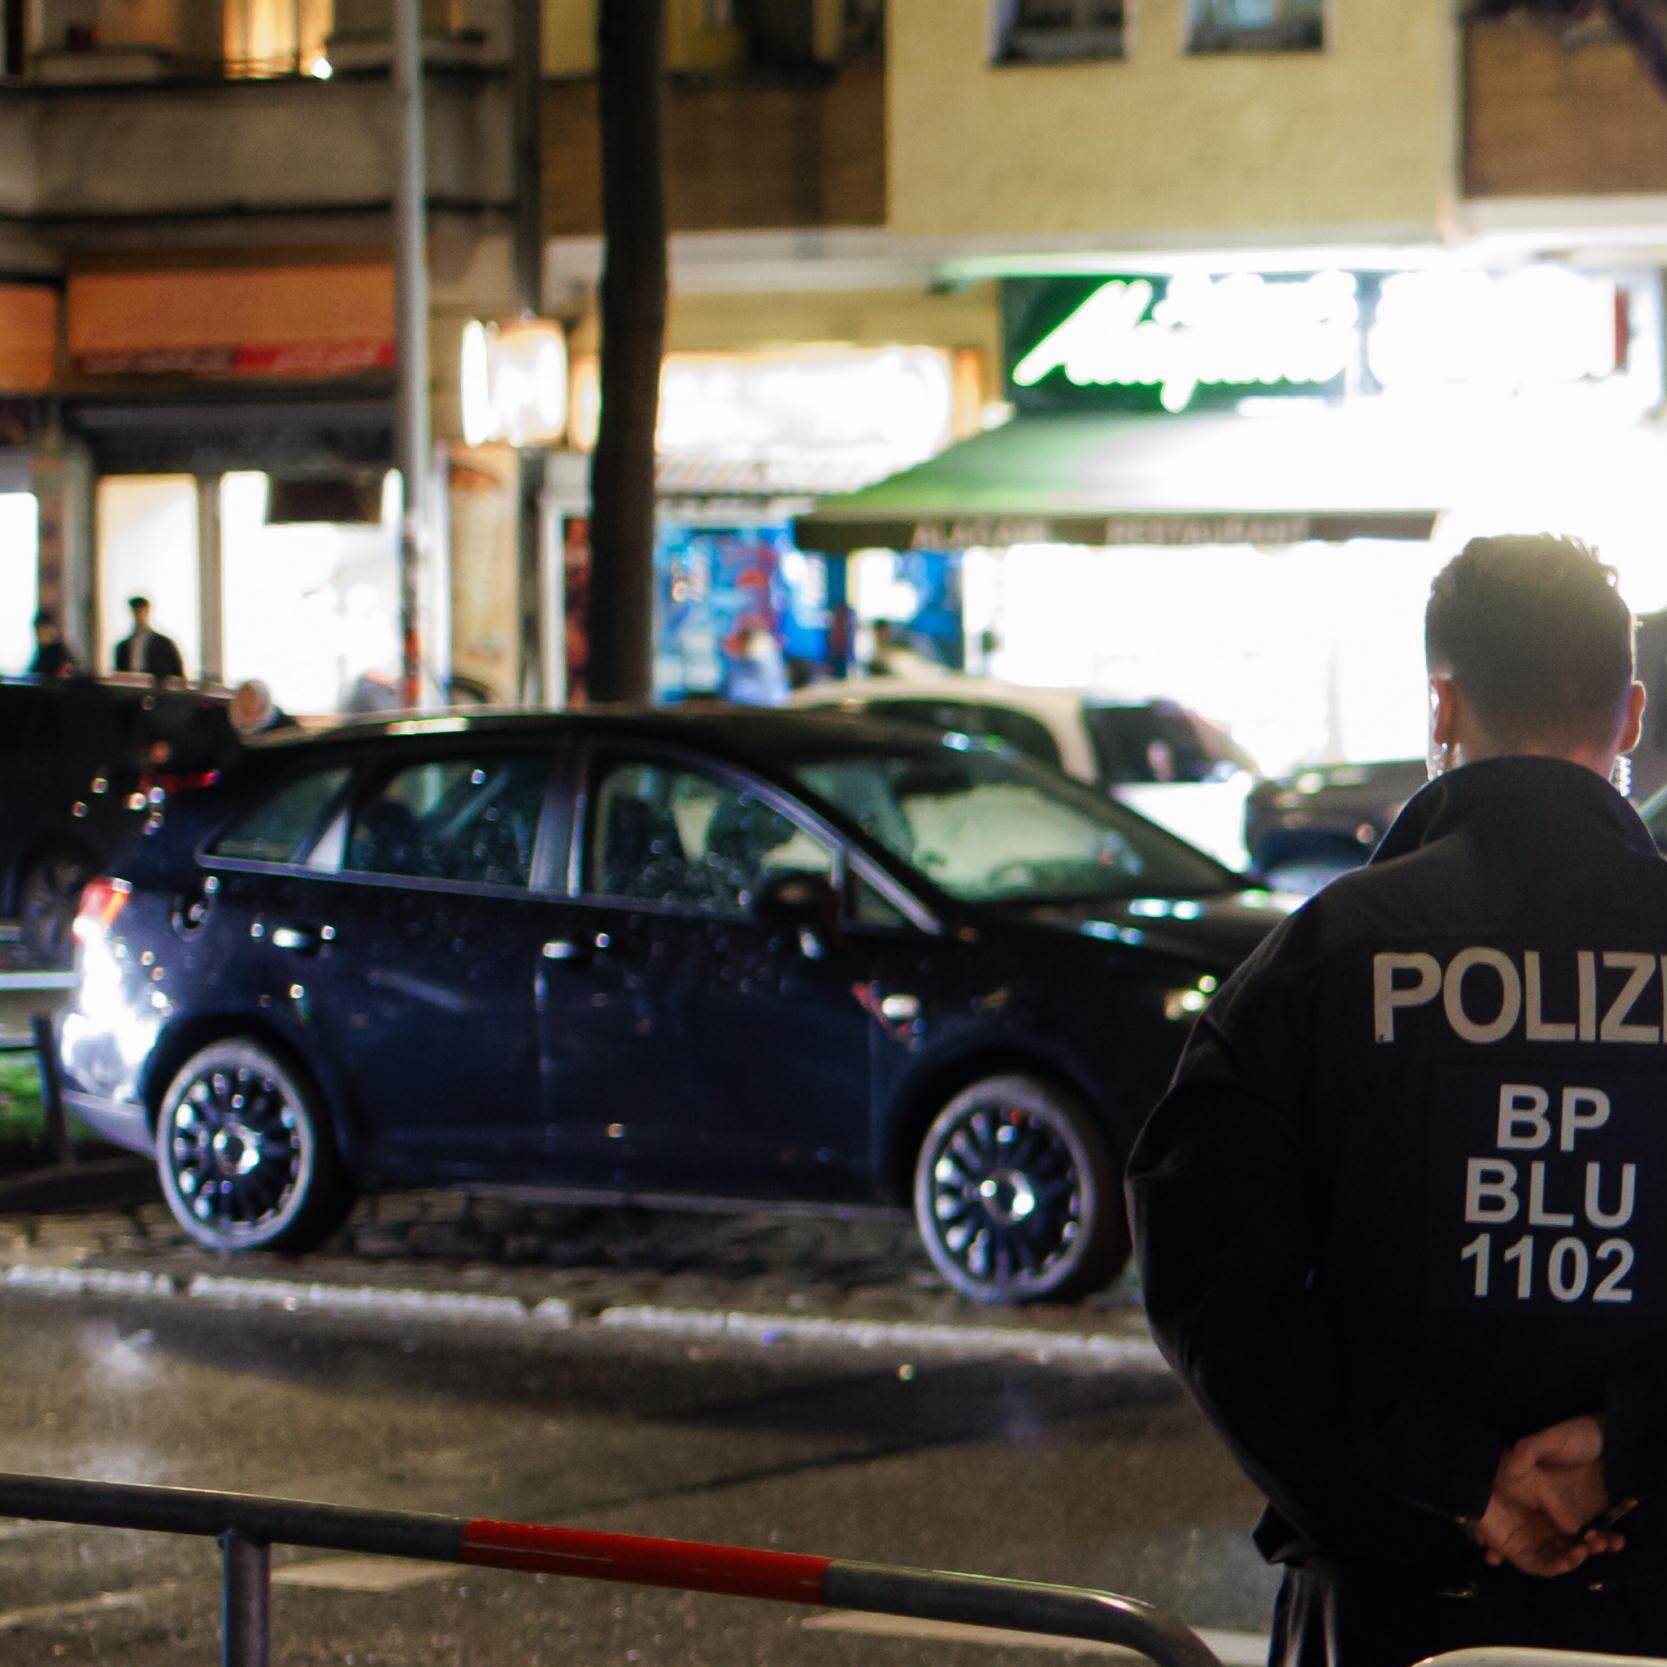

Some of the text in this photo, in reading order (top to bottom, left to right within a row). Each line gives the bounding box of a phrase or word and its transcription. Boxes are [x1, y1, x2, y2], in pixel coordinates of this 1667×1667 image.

[1496, 1083, 1611, 1152] BP
[1464, 1157, 1637, 1230] BLU
[1460, 1232, 1636, 1302] 1102
